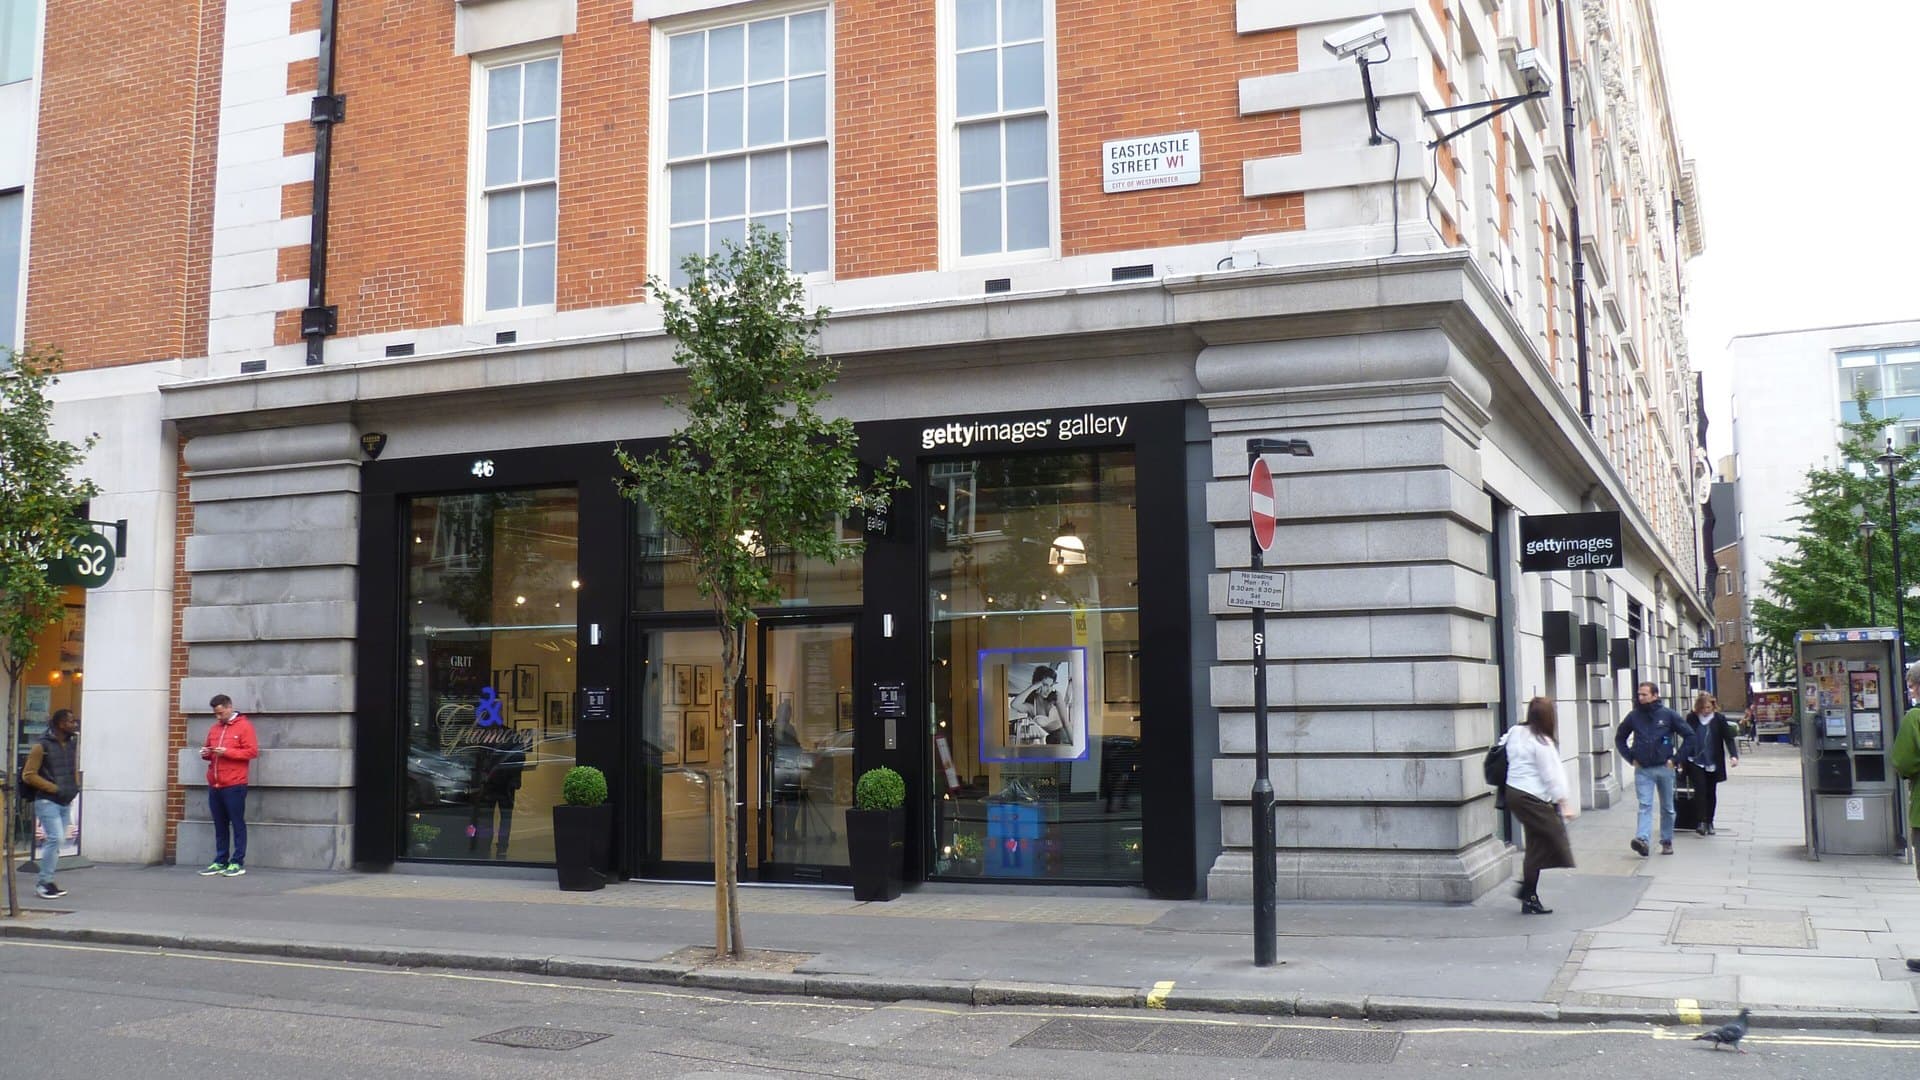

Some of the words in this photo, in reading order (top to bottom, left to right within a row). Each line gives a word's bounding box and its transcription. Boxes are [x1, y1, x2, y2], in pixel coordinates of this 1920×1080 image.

[1111, 139, 1189, 159] EASTCASTLE
[1111, 158, 1159, 175] STREET
[1166, 155, 1184, 169] W1
[1112, 182, 1125, 190] CITY
[1135, 175, 1179, 187] WESTMINSTER
[1058, 413, 1128, 440] gallery
[472, 460, 494, 478] 46
[1526, 537, 1613, 555] gettyimages
[1567, 552, 1613, 568] gallery
[1251, 573, 1273, 581] loading
[450, 655, 473, 668] GRIT
